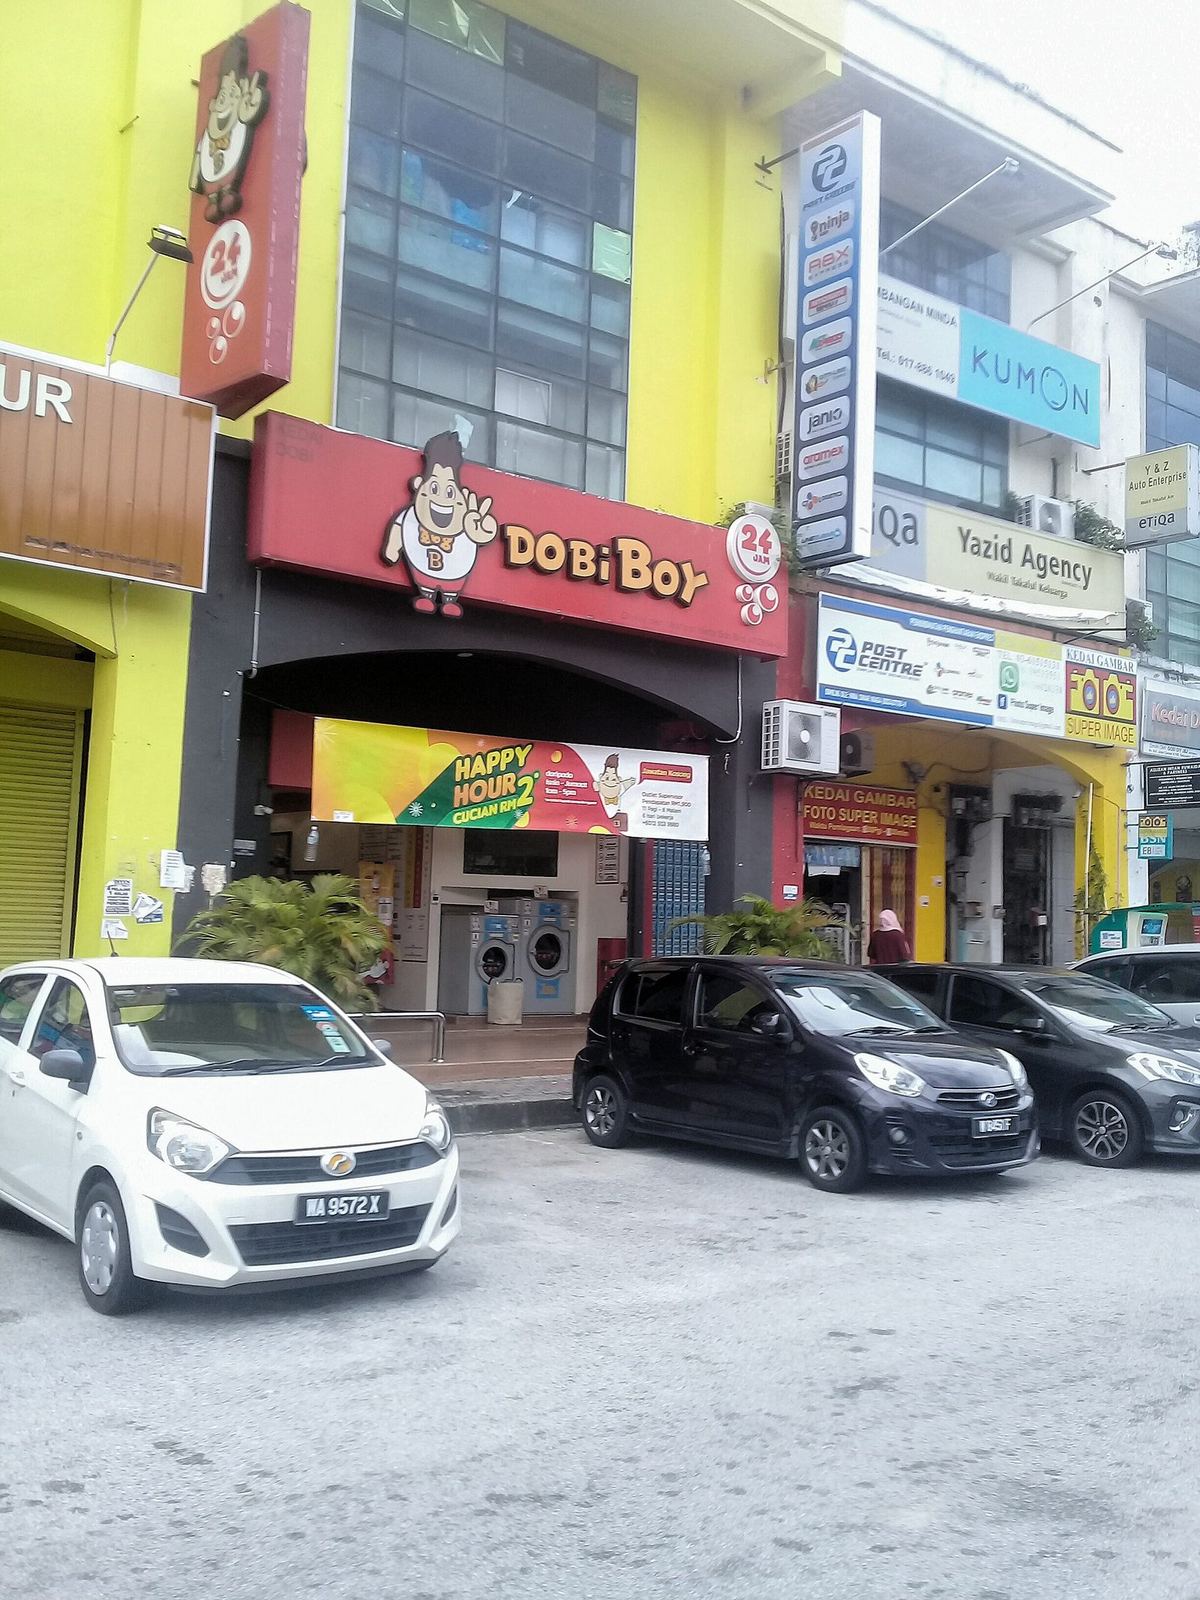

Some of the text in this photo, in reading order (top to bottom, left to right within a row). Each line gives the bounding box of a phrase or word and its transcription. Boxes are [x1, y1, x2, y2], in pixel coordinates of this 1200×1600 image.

[819, 210, 850, 230] ninja
[210, 232, 241, 276] 24
[972, 345, 1089, 415] KUMON
[0, 364, 73, 424] UR
[803, 445, 844, 465] aramex
[1145, 461, 1169, 475] Y & Z
[1128, 471, 1187, 491] Auto Enterprise
[1139, 513, 1175, 529] eTiQa
[741, 524, 773, 554] 24
[427, 550, 445, 571] B
[753, 554, 770, 565] JAM
[957, 526, 1093, 590] Yazid Agency
[861, 641, 908, 660] POST
[1067, 648, 1095, 665] KEDAI
[1096, 653, 1135, 673] GAMBAR
[858, 654, 923, 677] CENTRE
[1067, 717, 1102, 738] SUPER
[1104, 724, 1134, 744] IMAGE
[455, 744, 533, 782] HAPPY
[453, 773, 517, 808] HOUR
[804, 785, 917, 809] KEDAI GAMBAR
[452, 804, 498, 825] CUCIAN
[804, 805, 917, 828] FOTO SUPER IMAGE
[327, 1196, 368, 1216] 9572
[368, 1195, 381, 1214] X
